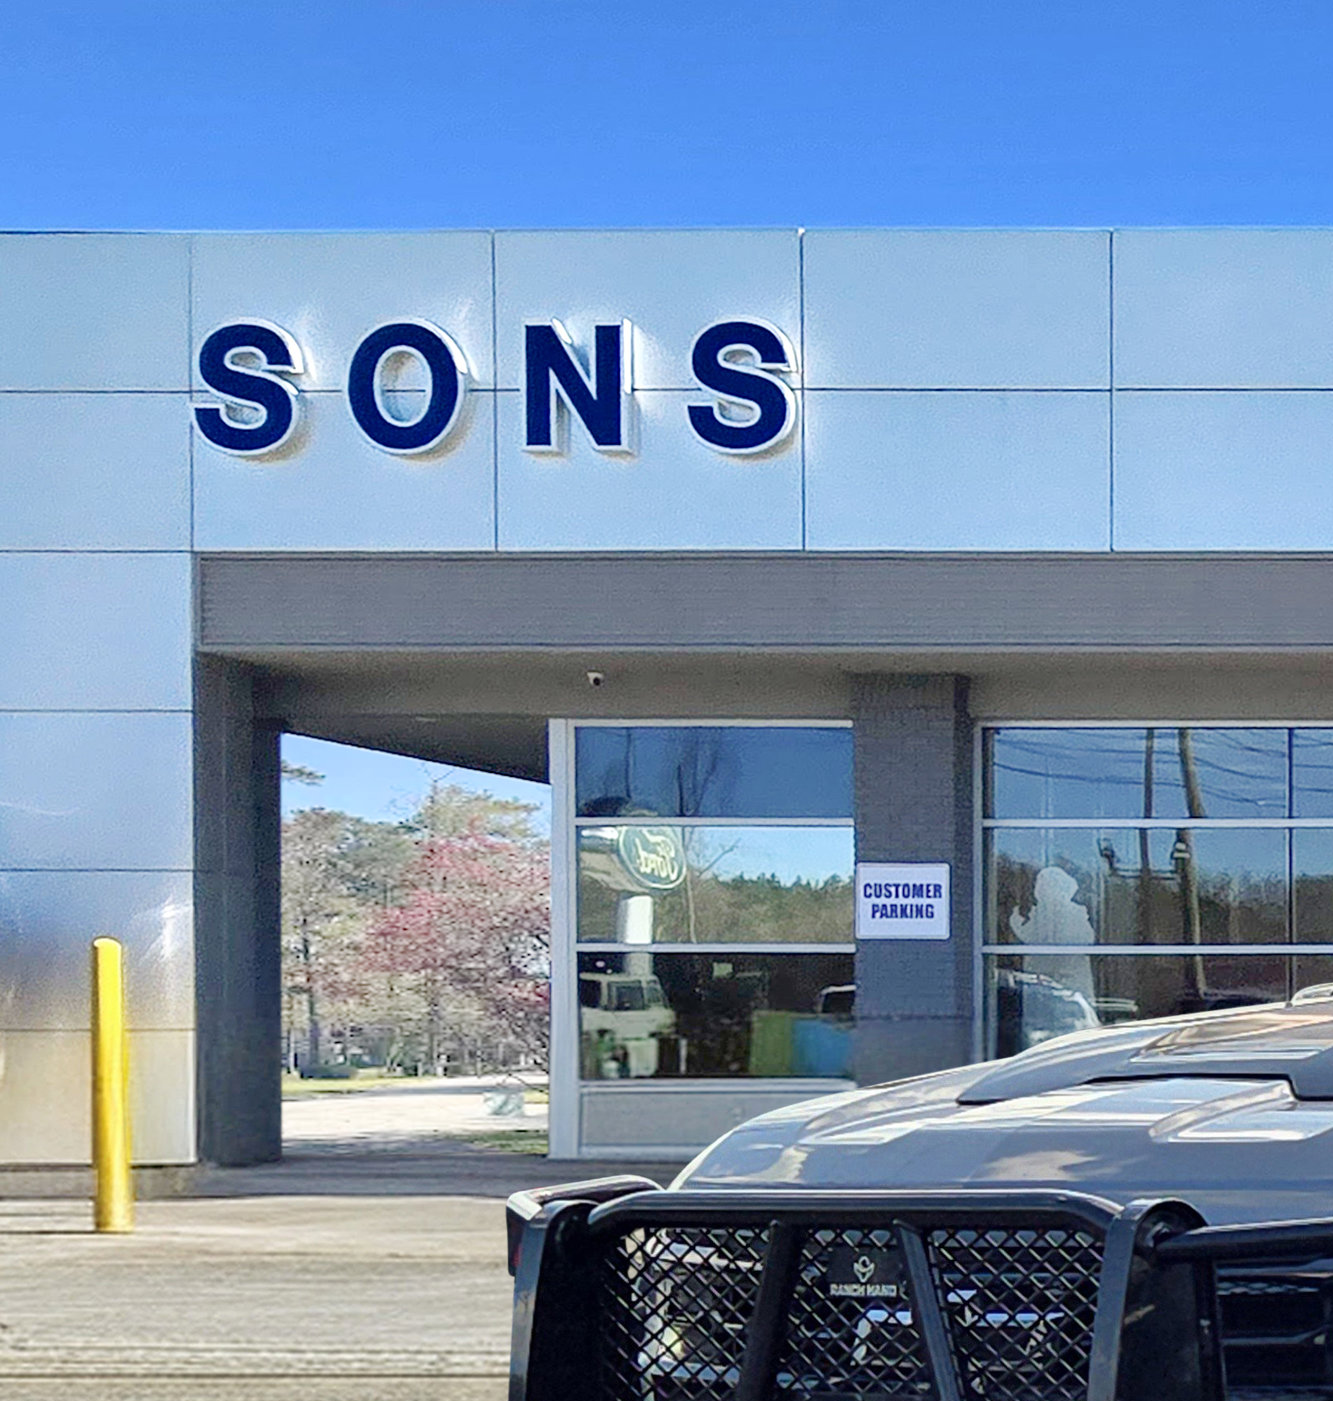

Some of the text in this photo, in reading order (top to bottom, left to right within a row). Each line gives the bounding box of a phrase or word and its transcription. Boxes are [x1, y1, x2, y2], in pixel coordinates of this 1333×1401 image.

[193, 318, 799, 456] SONS
[863, 883, 943, 899] CUSTOMER
[871, 903, 935, 919] PARKING
